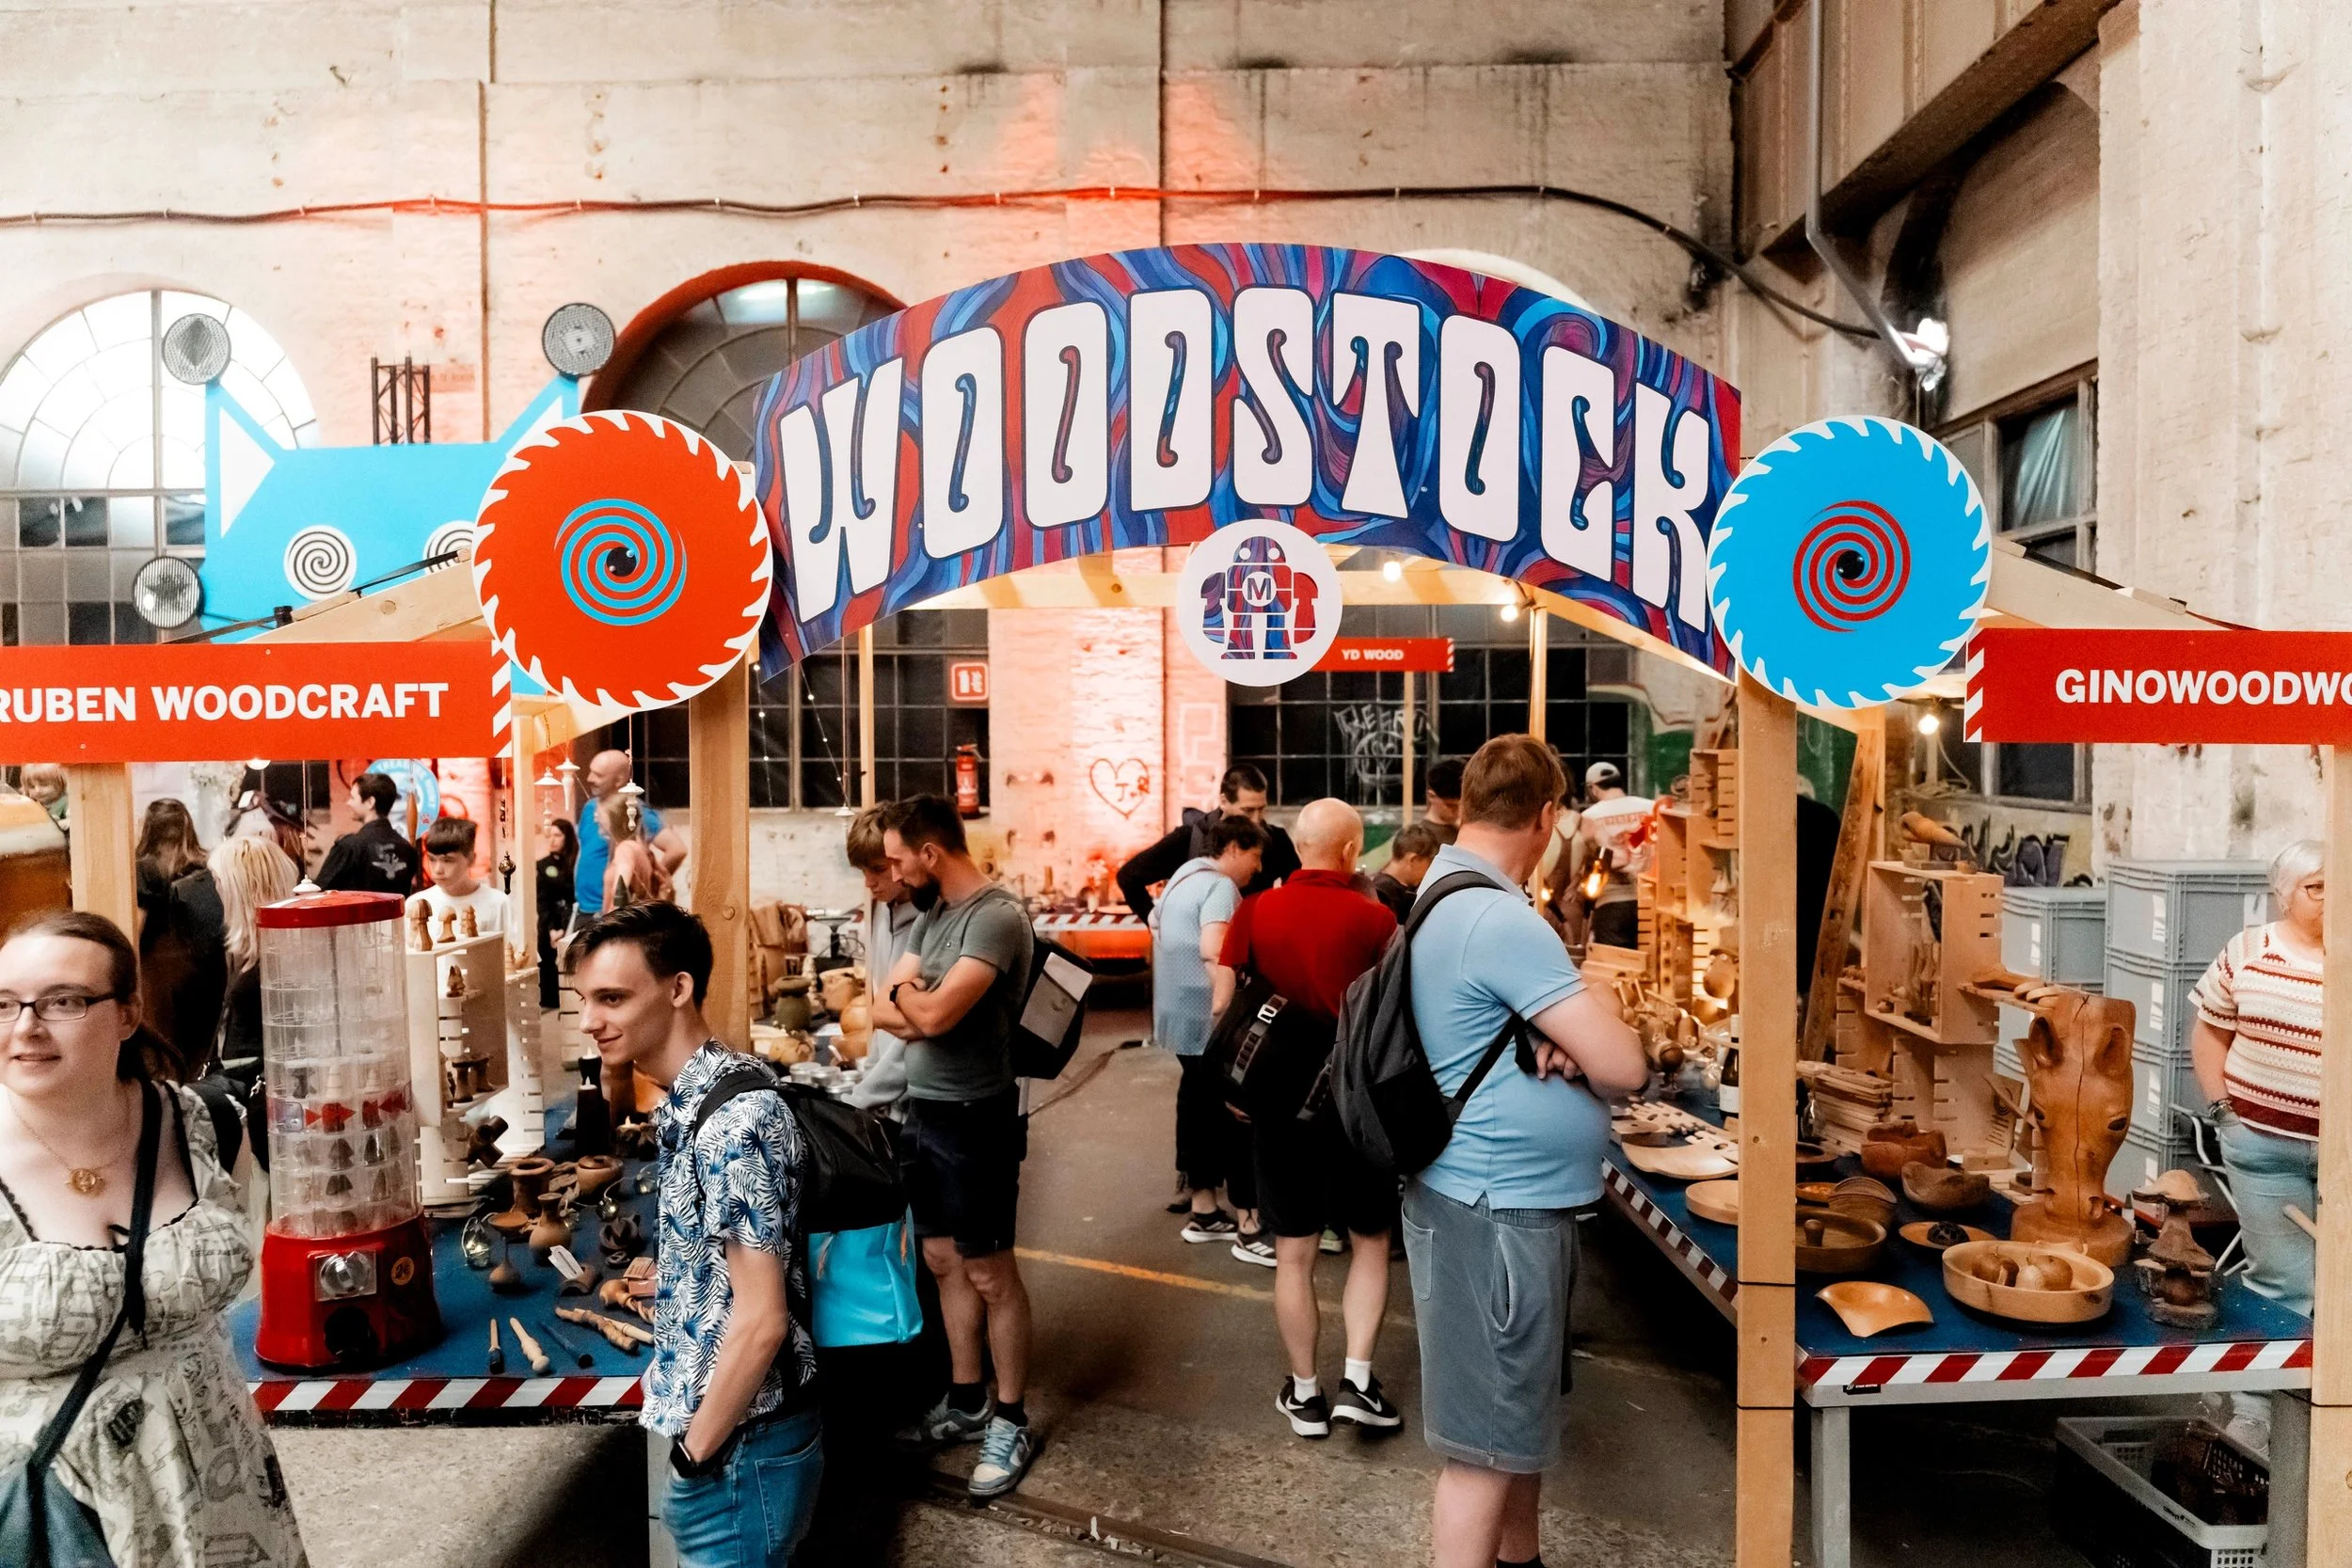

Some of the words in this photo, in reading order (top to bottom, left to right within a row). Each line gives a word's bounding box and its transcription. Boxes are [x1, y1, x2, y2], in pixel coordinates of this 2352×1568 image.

[780, 287, 1709, 634] WOODSTOCK
[1248, 578, 1271, 600] M
[1342, 649, 1360, 660] YD
[1363, 649, 1404, 660] WOOD
[151, 683, 449, 721] WOODCRAFT
